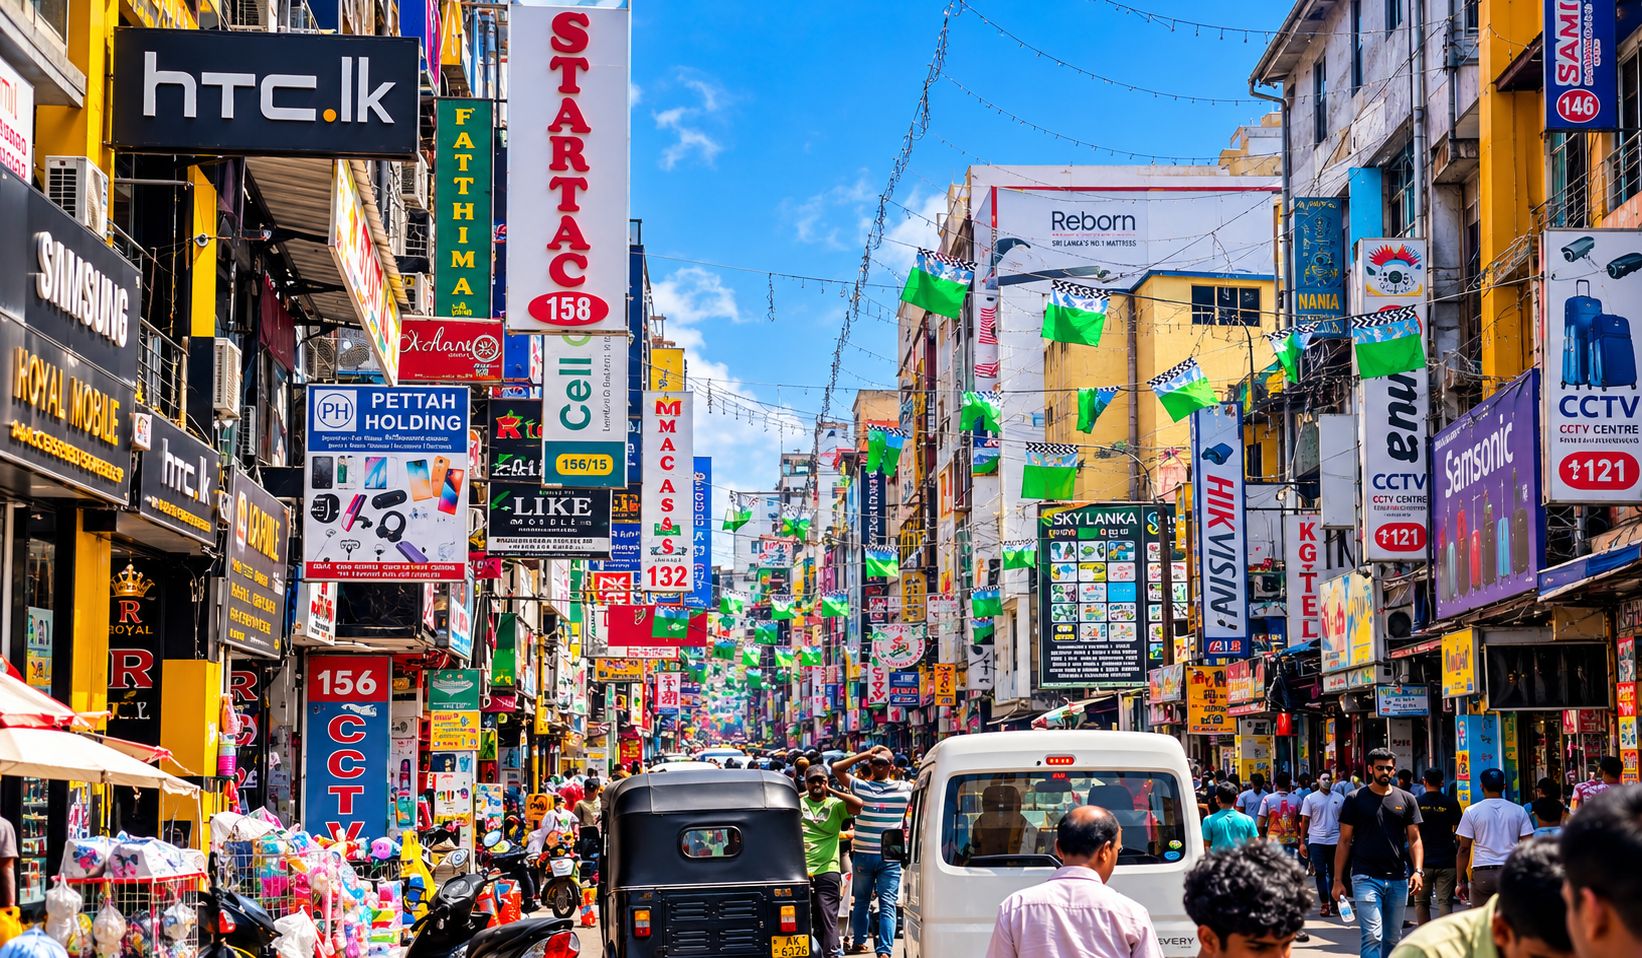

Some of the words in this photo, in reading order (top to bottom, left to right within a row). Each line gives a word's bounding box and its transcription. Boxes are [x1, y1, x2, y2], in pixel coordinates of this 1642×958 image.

[1562, 96, 1594, 116] 146
[546, 11, 591, 287] STARTAC
[451, 107, 476, 296] FATTHIMA
[1052, 211, 1136, 231] Reborn
[36, 232, 129, 348] SAMSUNG
[546, 296, 591, 321] 158
[1298, 293, 1340, 310] NANIA
[13, 346, 66, 420] ROYAL
[71, 376, 120, 447] MOBILE
[323, 403, 348, 419] PH
[371, 392, 456, 409] PETTAH
[1559, 395, 1641, 418] CCTV
[1593, 424, 1640, 434] CENTRE
[562, 458, 607, 471] 156/15
[1445, 414, 1514, 498] Samsonic
[1372, 473, 1427, 490] CCTV
[512, 497, 592, 516] LIKE
[1373, 495, 1394, 504] CCTV
[1396, 495, 1427, 504] CENTRE
[1053, 512, 1086, 526] SKY
[1086, 512, 1138, 526] LANKA
[647, 565, 688, 587] 132
[119, 600, 143, 624] R
[108, 648, 154, 689] R
[317, 669, 377, 695] 156
[325, 714, 367, 843] CCTV
[1157, 937, 1194, 946] EVERY
